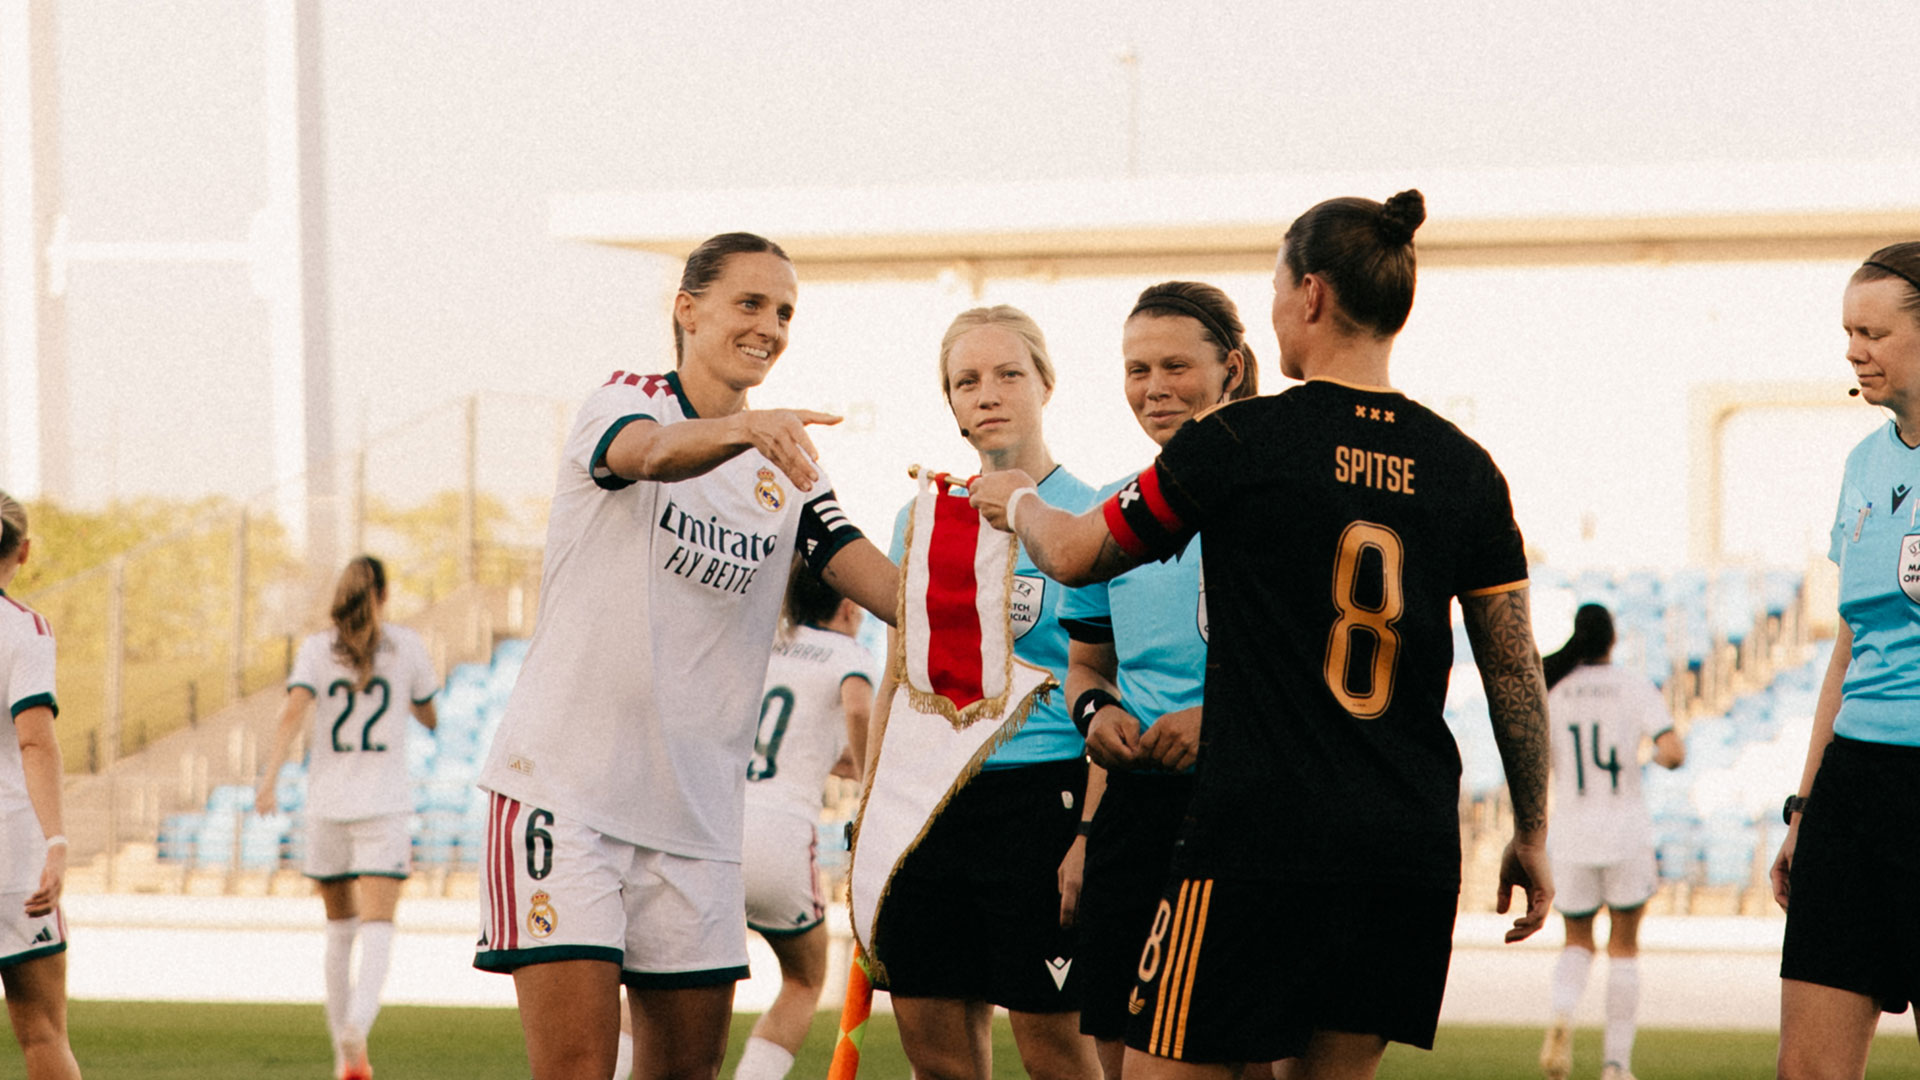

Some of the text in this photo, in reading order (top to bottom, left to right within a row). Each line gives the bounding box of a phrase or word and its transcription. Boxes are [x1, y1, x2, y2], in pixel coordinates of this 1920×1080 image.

[1335, 445, 1416, 495] SPITSE
[663, 545, 758, 595] FLY BETTE
[1010, 612, 1033, 623] ICIAL
[1012, 602, 1031, 612] TCH
[1323, 519, 1404, 720] 8
[328, 676, 390, 752] 22
[1567, 722, 1622, 795] 14
[525, 807, 555, 881] 6
[1138, 899, 1171, 982] 8
